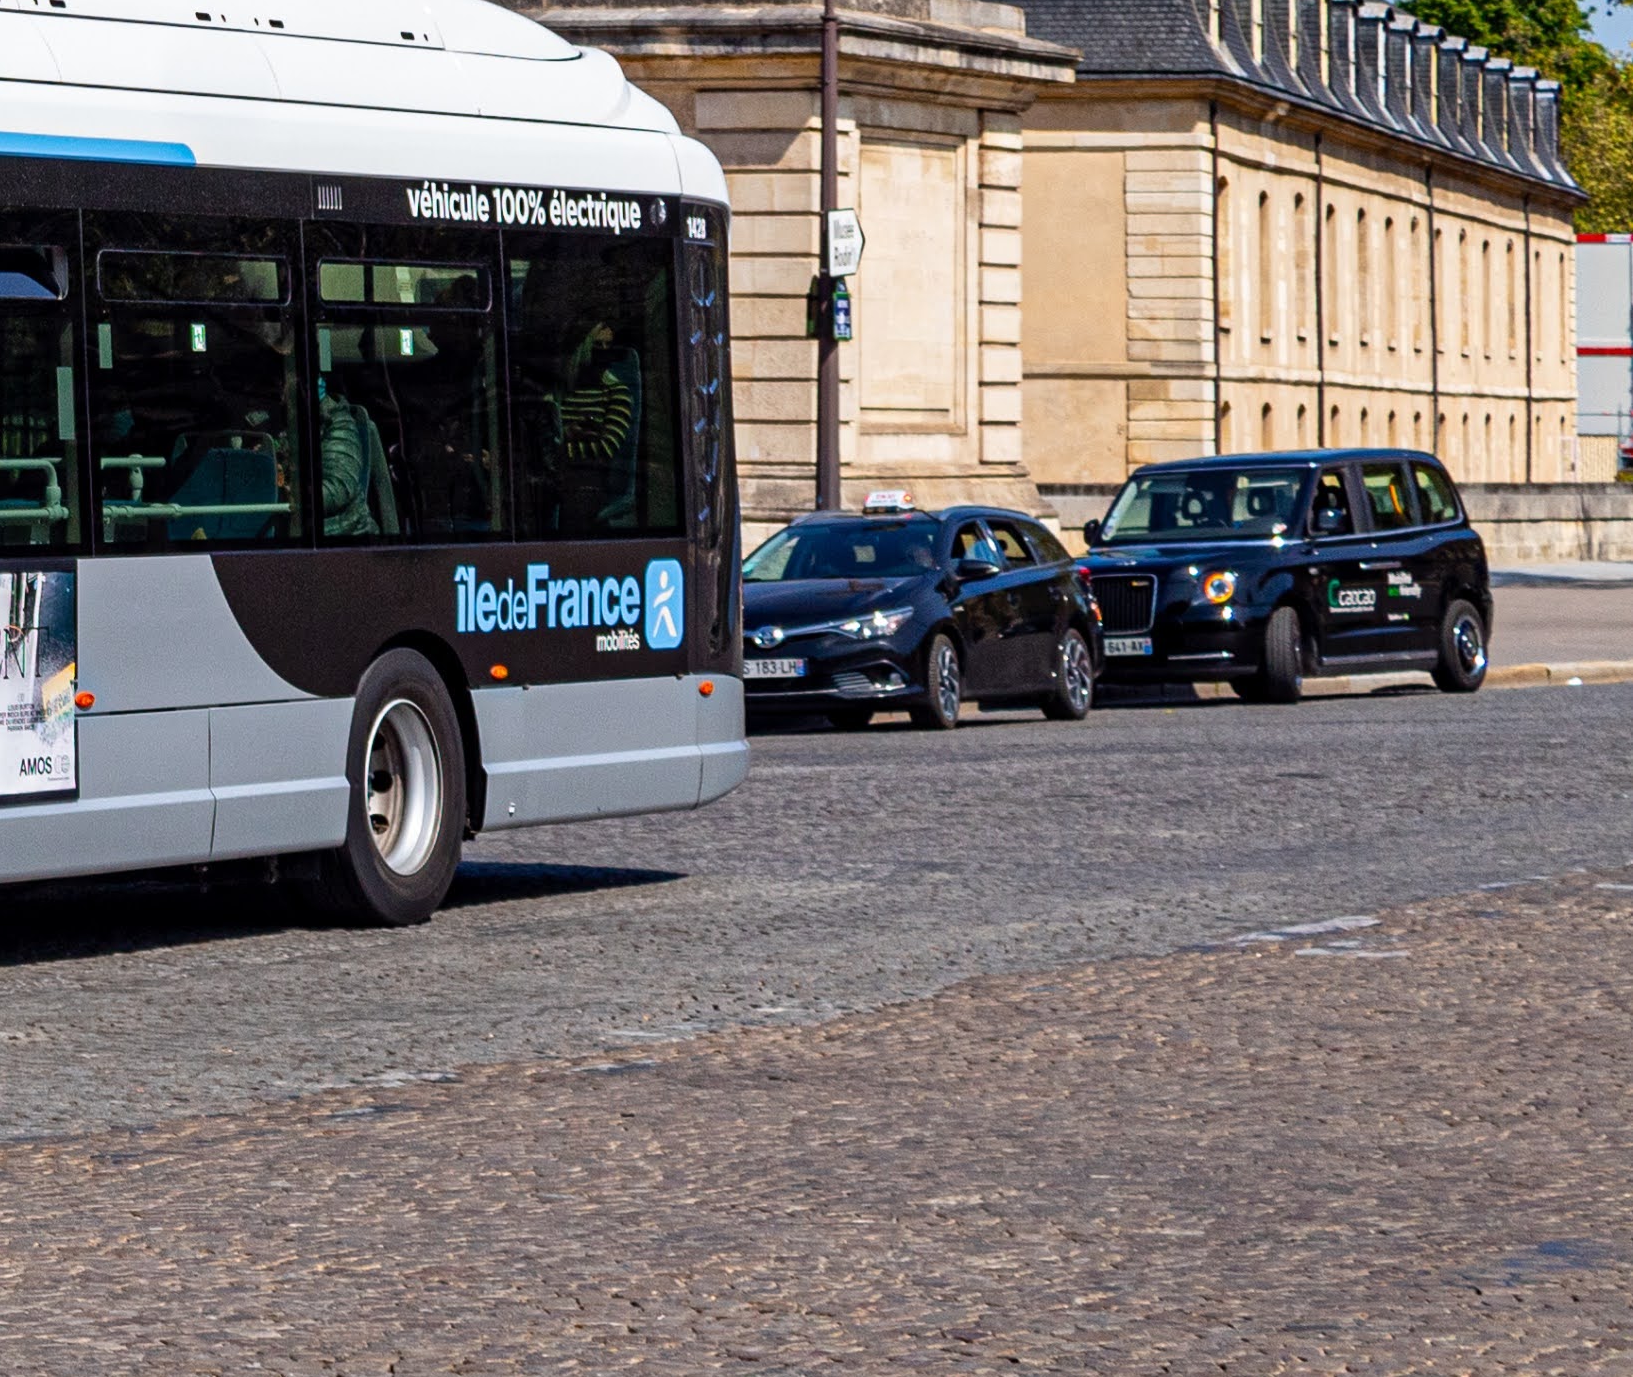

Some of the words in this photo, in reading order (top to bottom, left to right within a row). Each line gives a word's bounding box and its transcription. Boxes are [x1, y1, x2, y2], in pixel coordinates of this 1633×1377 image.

[406, 180, 490, 223] véhicule
[492, 187, 547, 226] 100%
[549, 189, 642, 235] électrique
[596, 628, 640, 652] mobilités
[19, 755, 53, 777] AMOS
